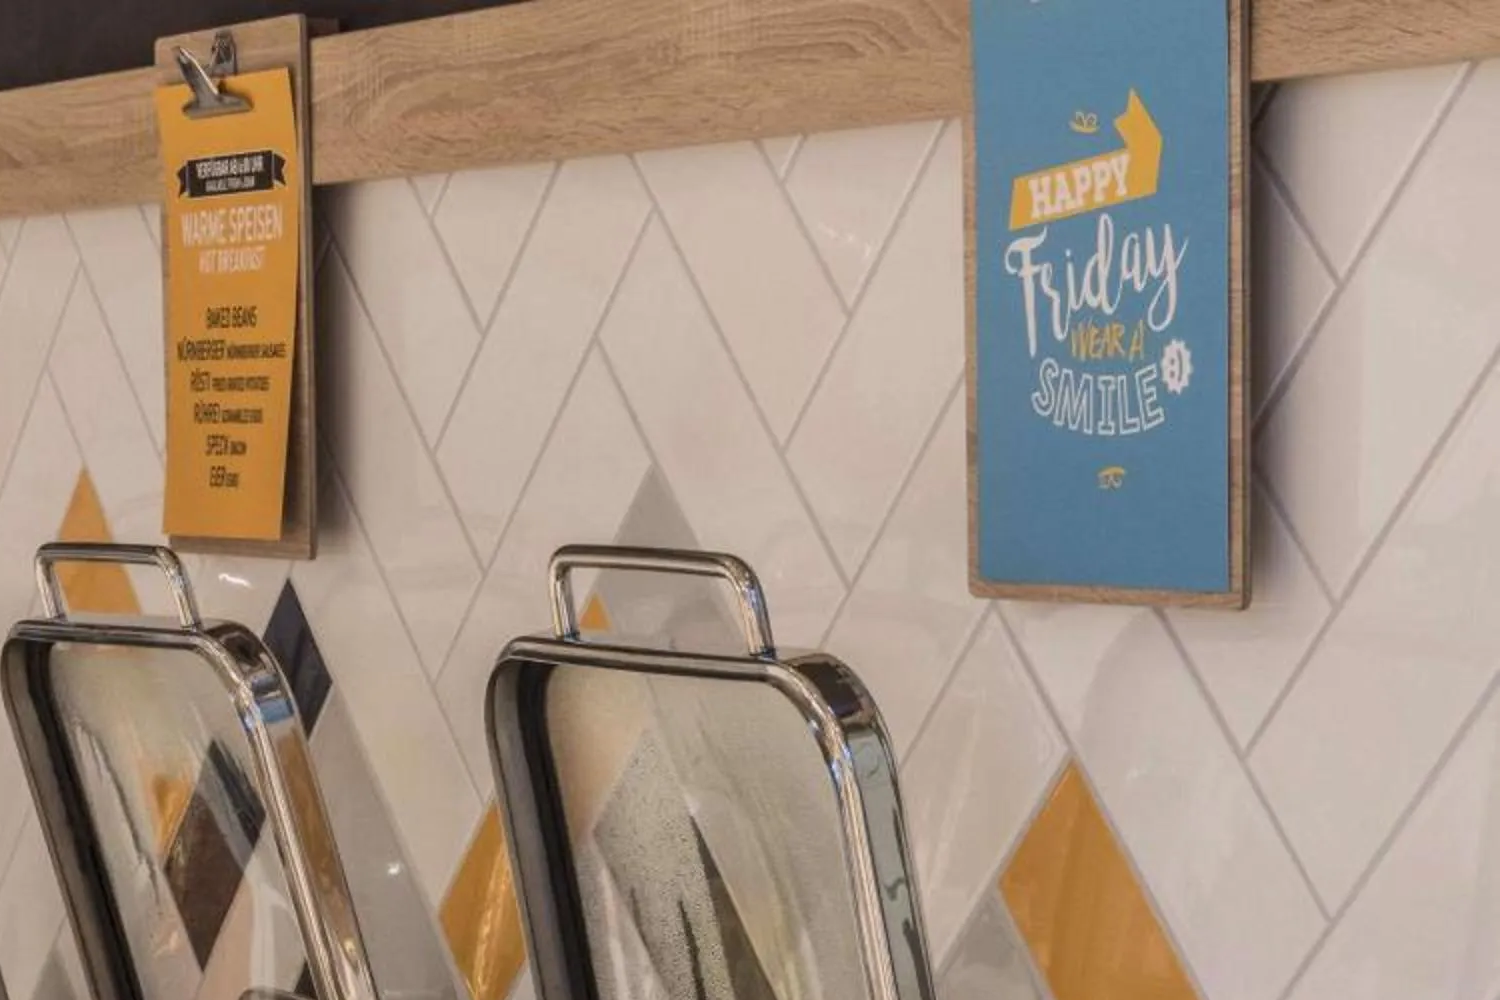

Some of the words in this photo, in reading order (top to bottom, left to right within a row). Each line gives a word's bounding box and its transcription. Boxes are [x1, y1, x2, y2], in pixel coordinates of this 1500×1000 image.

[1028, 153, 1130, 218] HAPPY
[181, 209, 226, 247] WARME
[229, 203, 284, 243] SPEISEN
[1005, 213, 1189, 358] Friday
[232, 306, 257, 328] BEANS
[1071, 318, 1125, 361] WEAR
[1128, 319, 1146, 362] A
[1031, 357, 1166, 435] SMILE
